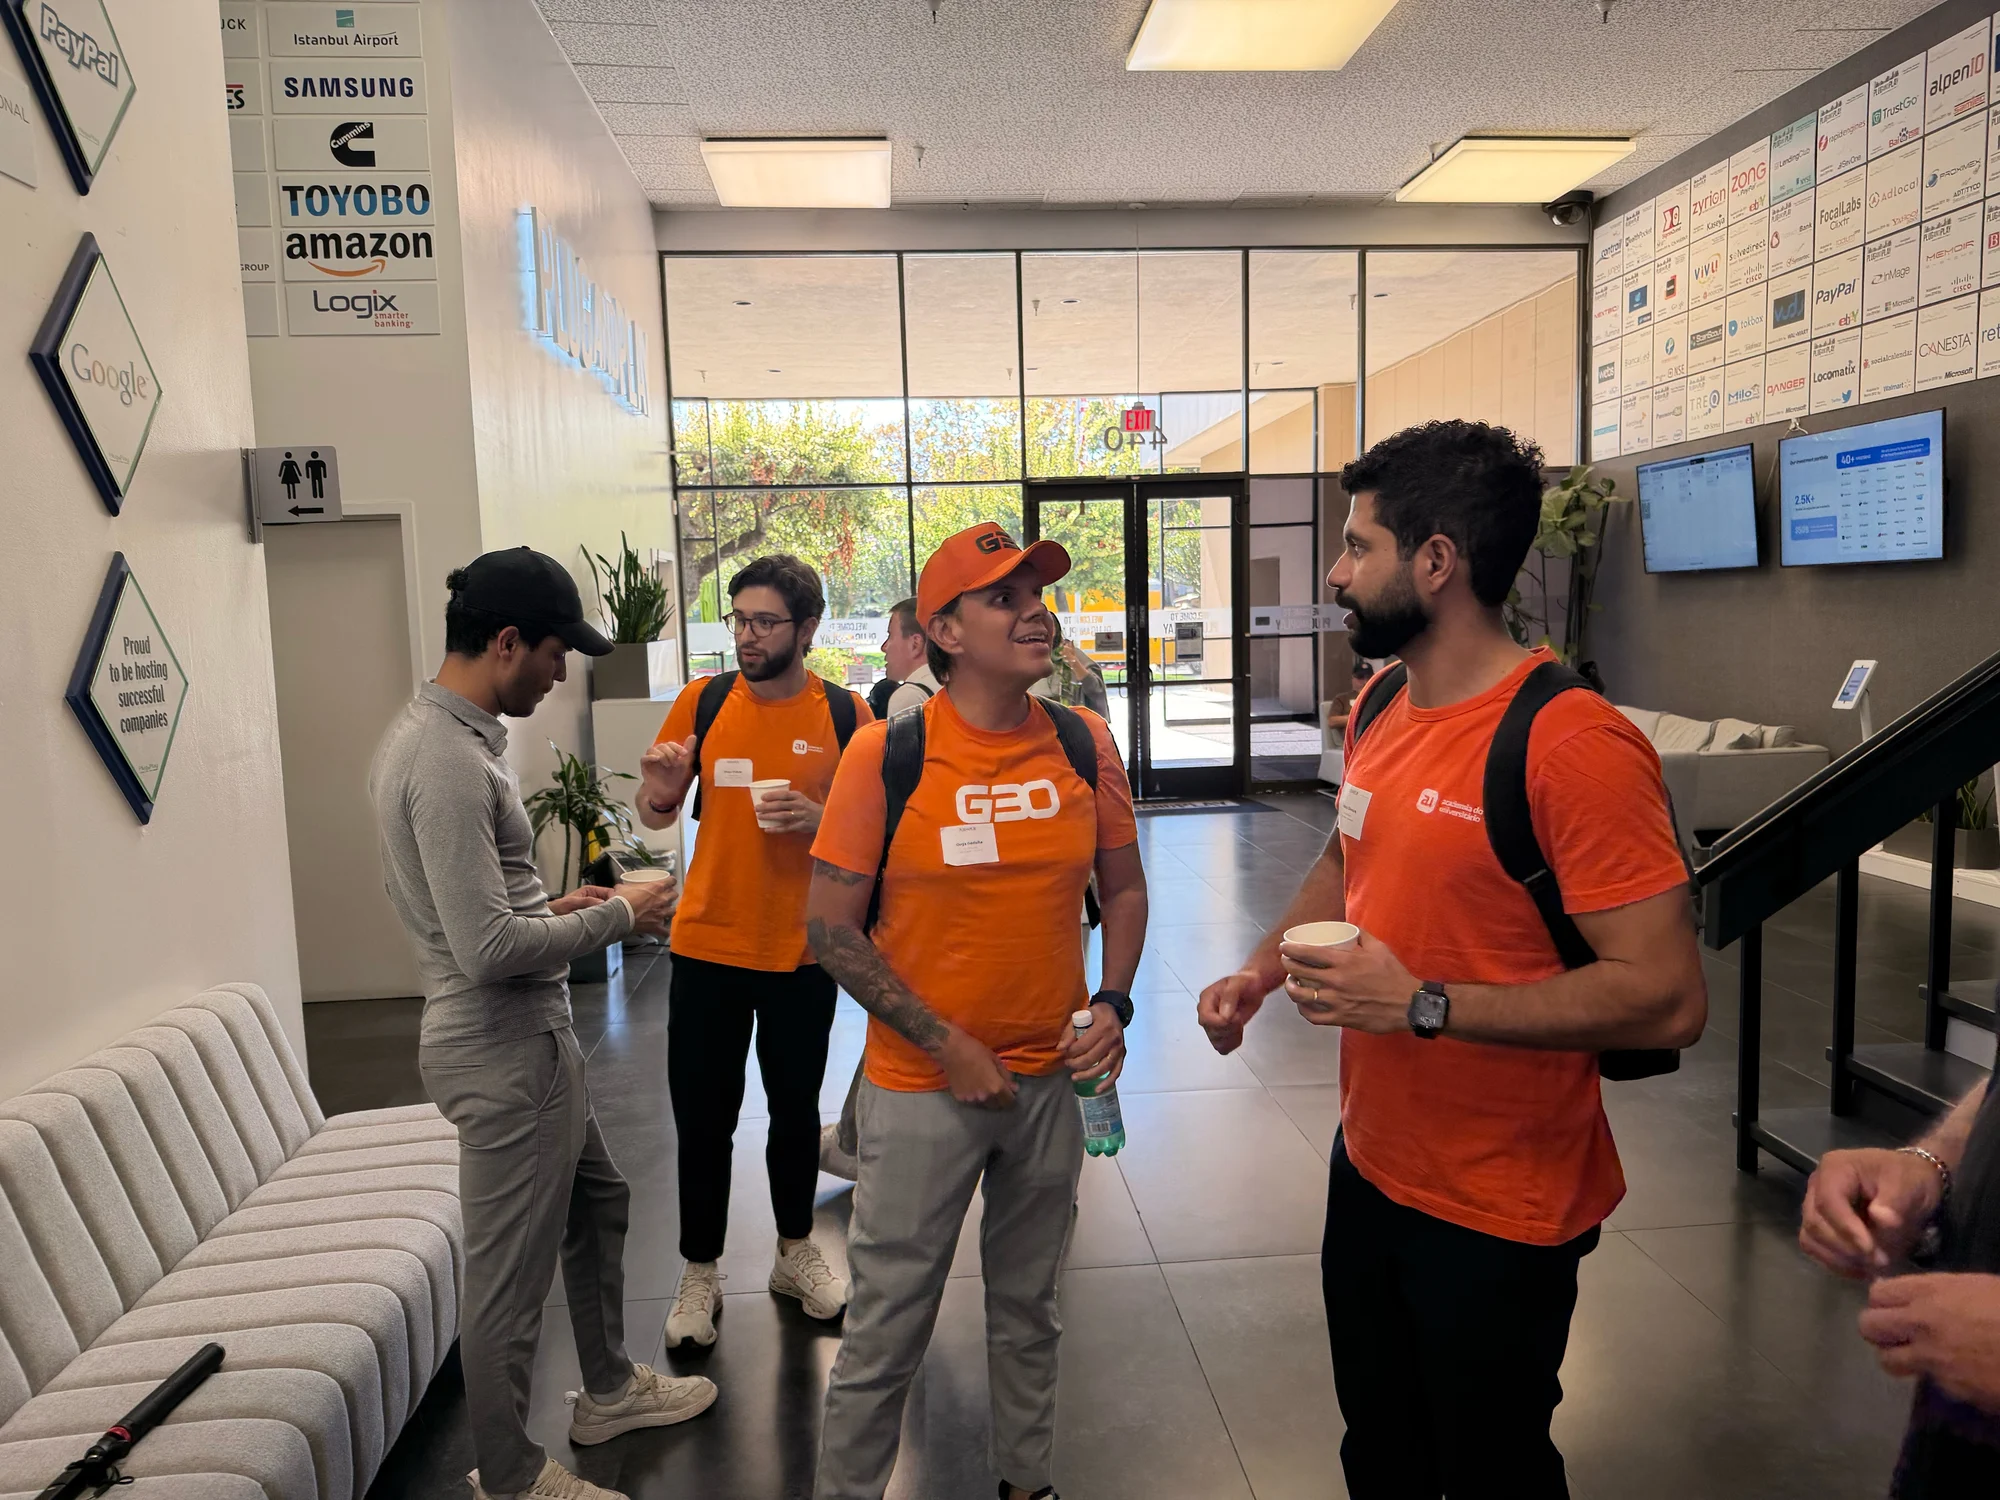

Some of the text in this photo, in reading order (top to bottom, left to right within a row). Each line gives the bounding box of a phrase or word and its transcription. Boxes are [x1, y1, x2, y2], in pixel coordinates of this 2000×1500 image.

[41, 2, 118, 87] PayPal
[294, 32, 399, 48] Istanbul Airport
[284, 77, 414, 98] SAMSUNG
[1883, 95, 1918, 119] TrustGo
[330, 121, 371, 149] Cummins
[1779, 147, 1811, 168] LendingClub
[282, 184, 430, 216] TOYOBO
[1881, 177, 1919, 202] Adlocal
[1692, 188, 1727, 216] zyrion
[1749, 194, 1766, 212] ebY
[1820, 196, 1862, 224] FocalLabs
[1829, 217, 1850, 230] Clixtr
[286, 232, 433, 260] amazon
[1926, 240, 1975, 262] MEMOIR
[1816, 278, 1856, 305] PayPal
[1893, 296, 1915, 308] Microsoft
[313, 289, 399, 319] Logix
[1741, 315, 1764, 329] tokbox
[1919, 333, 1972, 357] CANESTA
[1871, 349, 1913, 366] socialcalendar
[71, 343, 149, 406] Google
[1813, 363, 1856, 384] Locomatix
[1944, 367, 1974, 380] Microsoft
[1728, 388, 1752, 402] Milo
[1767, 378, 1806, 396] DANGER
[1883, 382, 1904, 392] Walmart
[1745, 411, 1762, 425] ebY
[1785, 404, 1807, 414] Microsoft
[1126, 410, 1153, 431] EXIT
[1794, 494, 1815, 505] 2.5K+
[123, 636, 151, 656] Proud
[109, 660, 169, 683] to be hosting
[118, 684, 165, 708] successful
[120, 710, 169, 734] companies
[956, 779, 1060, 824] G30
